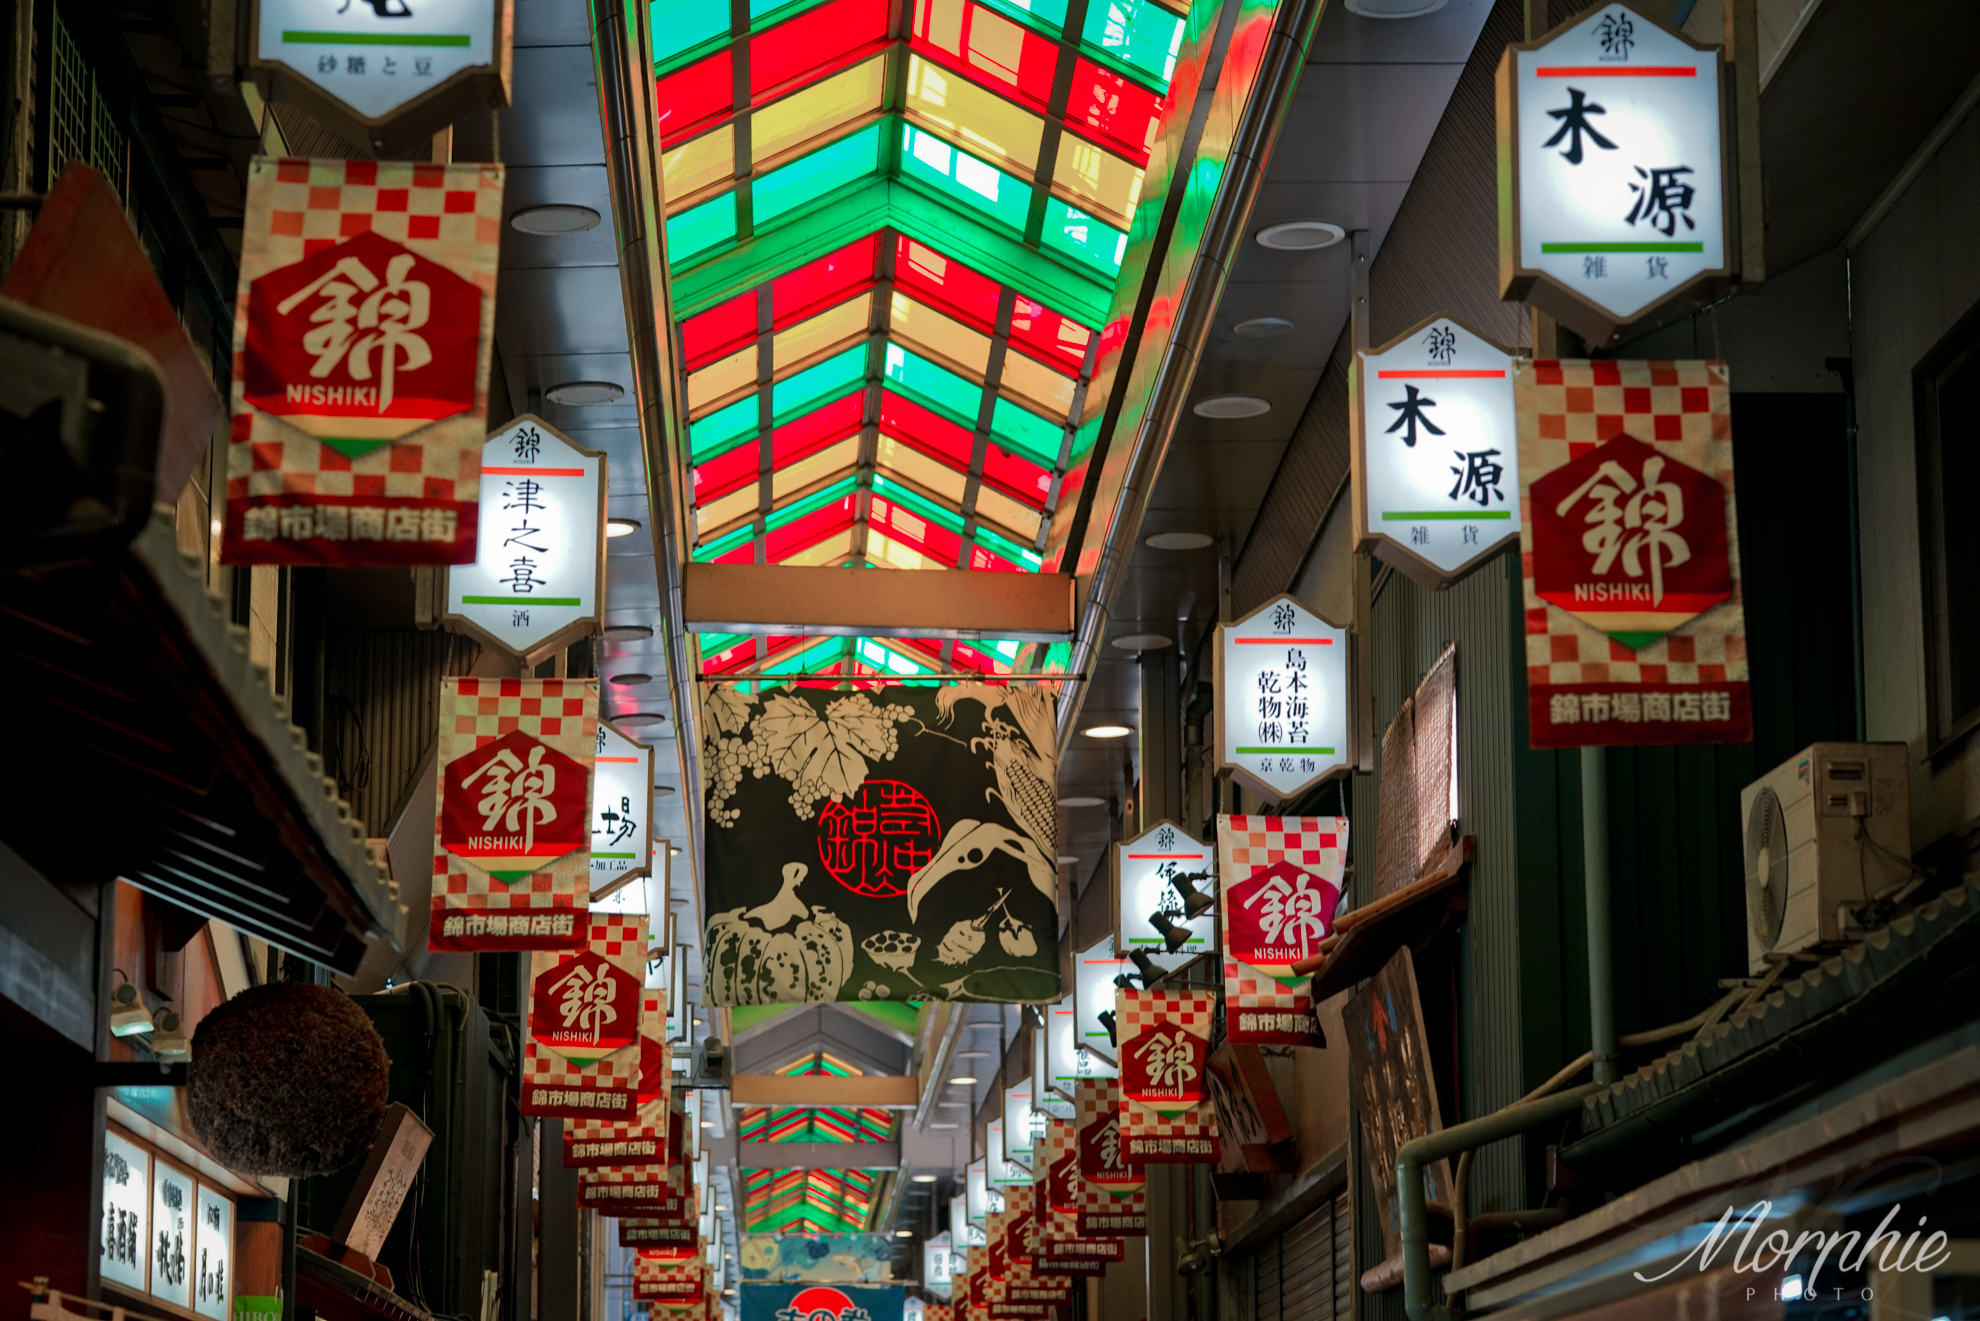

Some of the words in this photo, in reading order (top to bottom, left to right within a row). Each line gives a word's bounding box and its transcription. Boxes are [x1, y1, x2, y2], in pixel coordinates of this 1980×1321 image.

[317, 55, 433, 76] 砂糖と豆
[1541, 86, 1697, 236] 木源
[1583, 255, 1668, 280] 雑貨
[276, 254, 432, 414] 錦
[1422, 326, 1456, 365] 錦
[287, 384, 377, 407] NISHIKI
[509, 427, 540, 464] 錦
[1384, 384, 1505, 506] 木源
[242, 506, 457, 543] 錦市場商店街
[499, 478, 549, 593] 津之喜
[1411, 525, 1479, 546] 雑貨
[1555, 456, 1691, 608] 錦
[1574, 583, 1649, 602] NISHIKI
[512, 610, 530, 627] 酒
[1269, 604, 1295, 635] 錦
[1285, 648, 1309, 744] 島本海苔
[1550, 691, 1730, 724] 錦市場商店街
[1259, 758, 1315, 773] 京乾物
[461, 745, 557, 854] 錦
[592, 796, 637, 846] 場
[468, 836, 523, 850] NISHIKI
[443, 914, 574, 937] 錦市場商店街
[1243, 873, 1325, 961] 錦
[1254, 948, 1300, 960] NISHIKI
[548, 962, 617, 1046] 錦
[552, 1030, 593, 1043] NISHIKI
[1133, 1031, 1197, 1100] 錦
[531, 1089, 628, 1110] 錦市場商店街
[1141, 1088, 1178, 1098] NISHIKI
[572, 1140, 656, 1158] 錦市場商店街
[1130, 1138, 1213, 1155] 錦市場商店街
[1096, 1171, 1127, 1180] NISHIKI
[585, 1185, 659, 1199] 錦市場商店街
